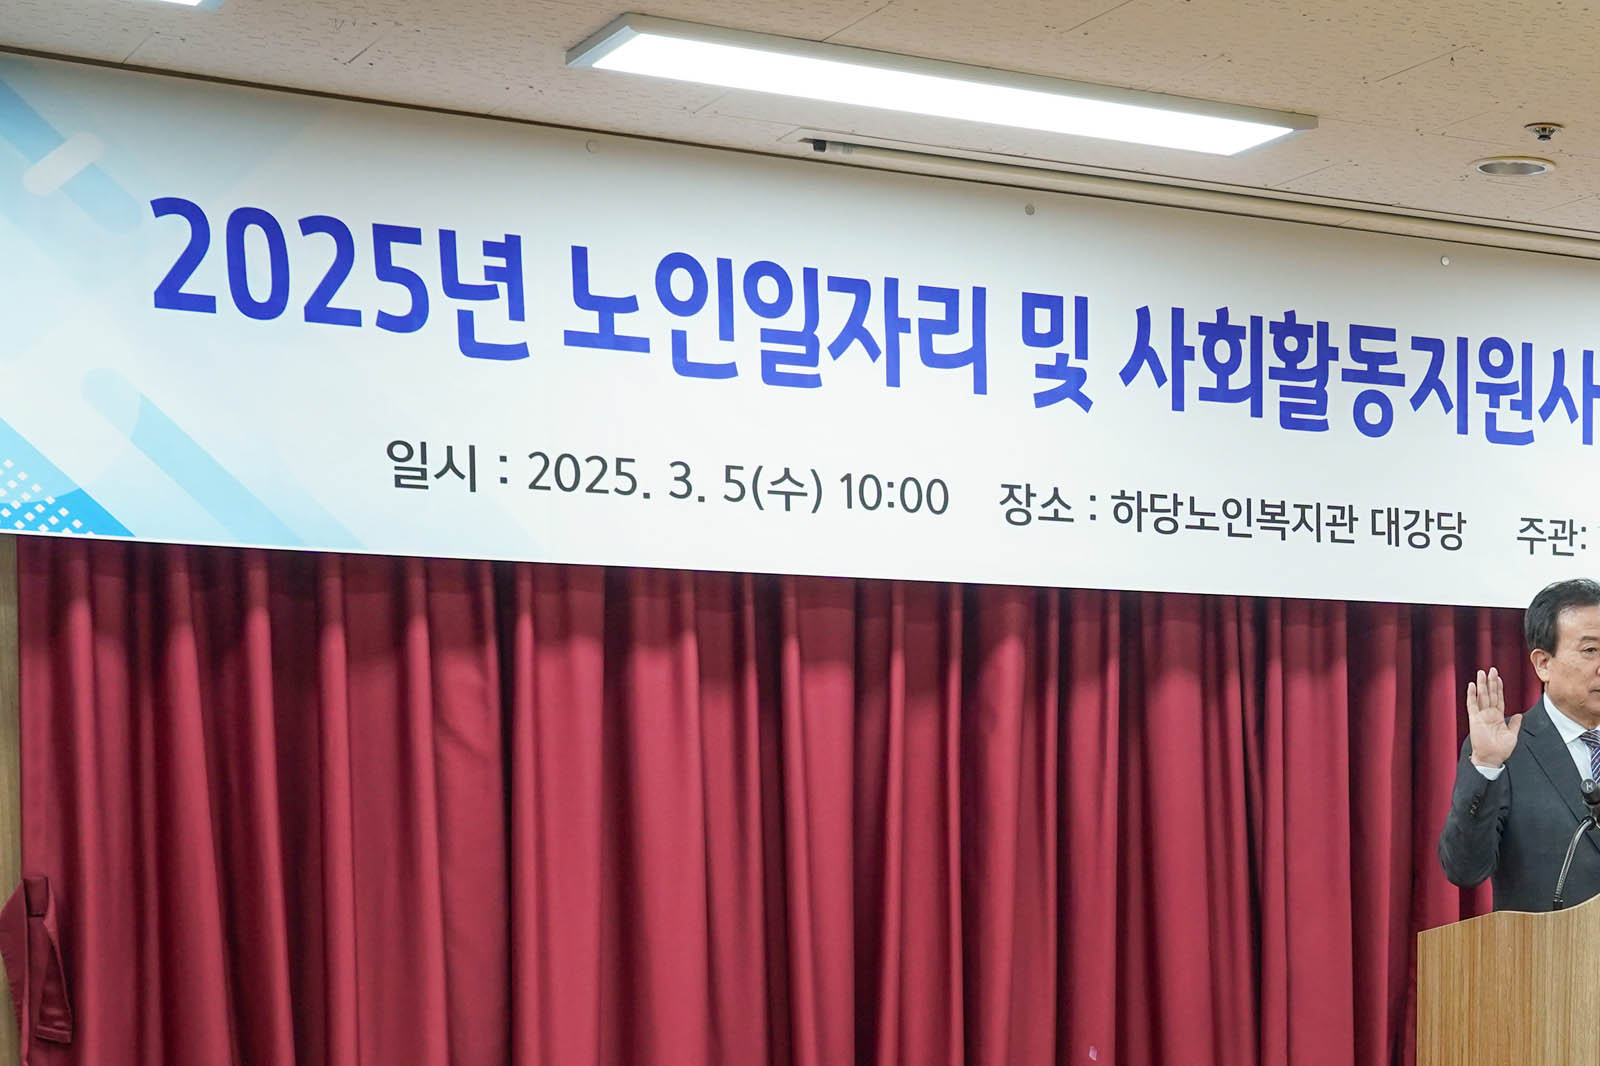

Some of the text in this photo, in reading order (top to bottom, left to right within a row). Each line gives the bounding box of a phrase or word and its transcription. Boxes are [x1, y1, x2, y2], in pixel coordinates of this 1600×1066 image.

[149, 196, 530, 361] 2025년
[563, 245, 987, 395] 노인일자리
[1021, 291, 1093, 413] 및
[386, 440, 477, 493] 일시
[528, 451, 651, 499] 2025.
[669, 460, 705, 503] 3.
[723, 464, 823, 514] 5(수)
[840, 473, 949, 515] 10:00
[999, 482, 1075, 526] 장소
[1110, 489, 1359, 544] 하당노인복지관
[1371, 507, 1467, 551] 대강당
[1516, 517, 1587, 557] 주관:
